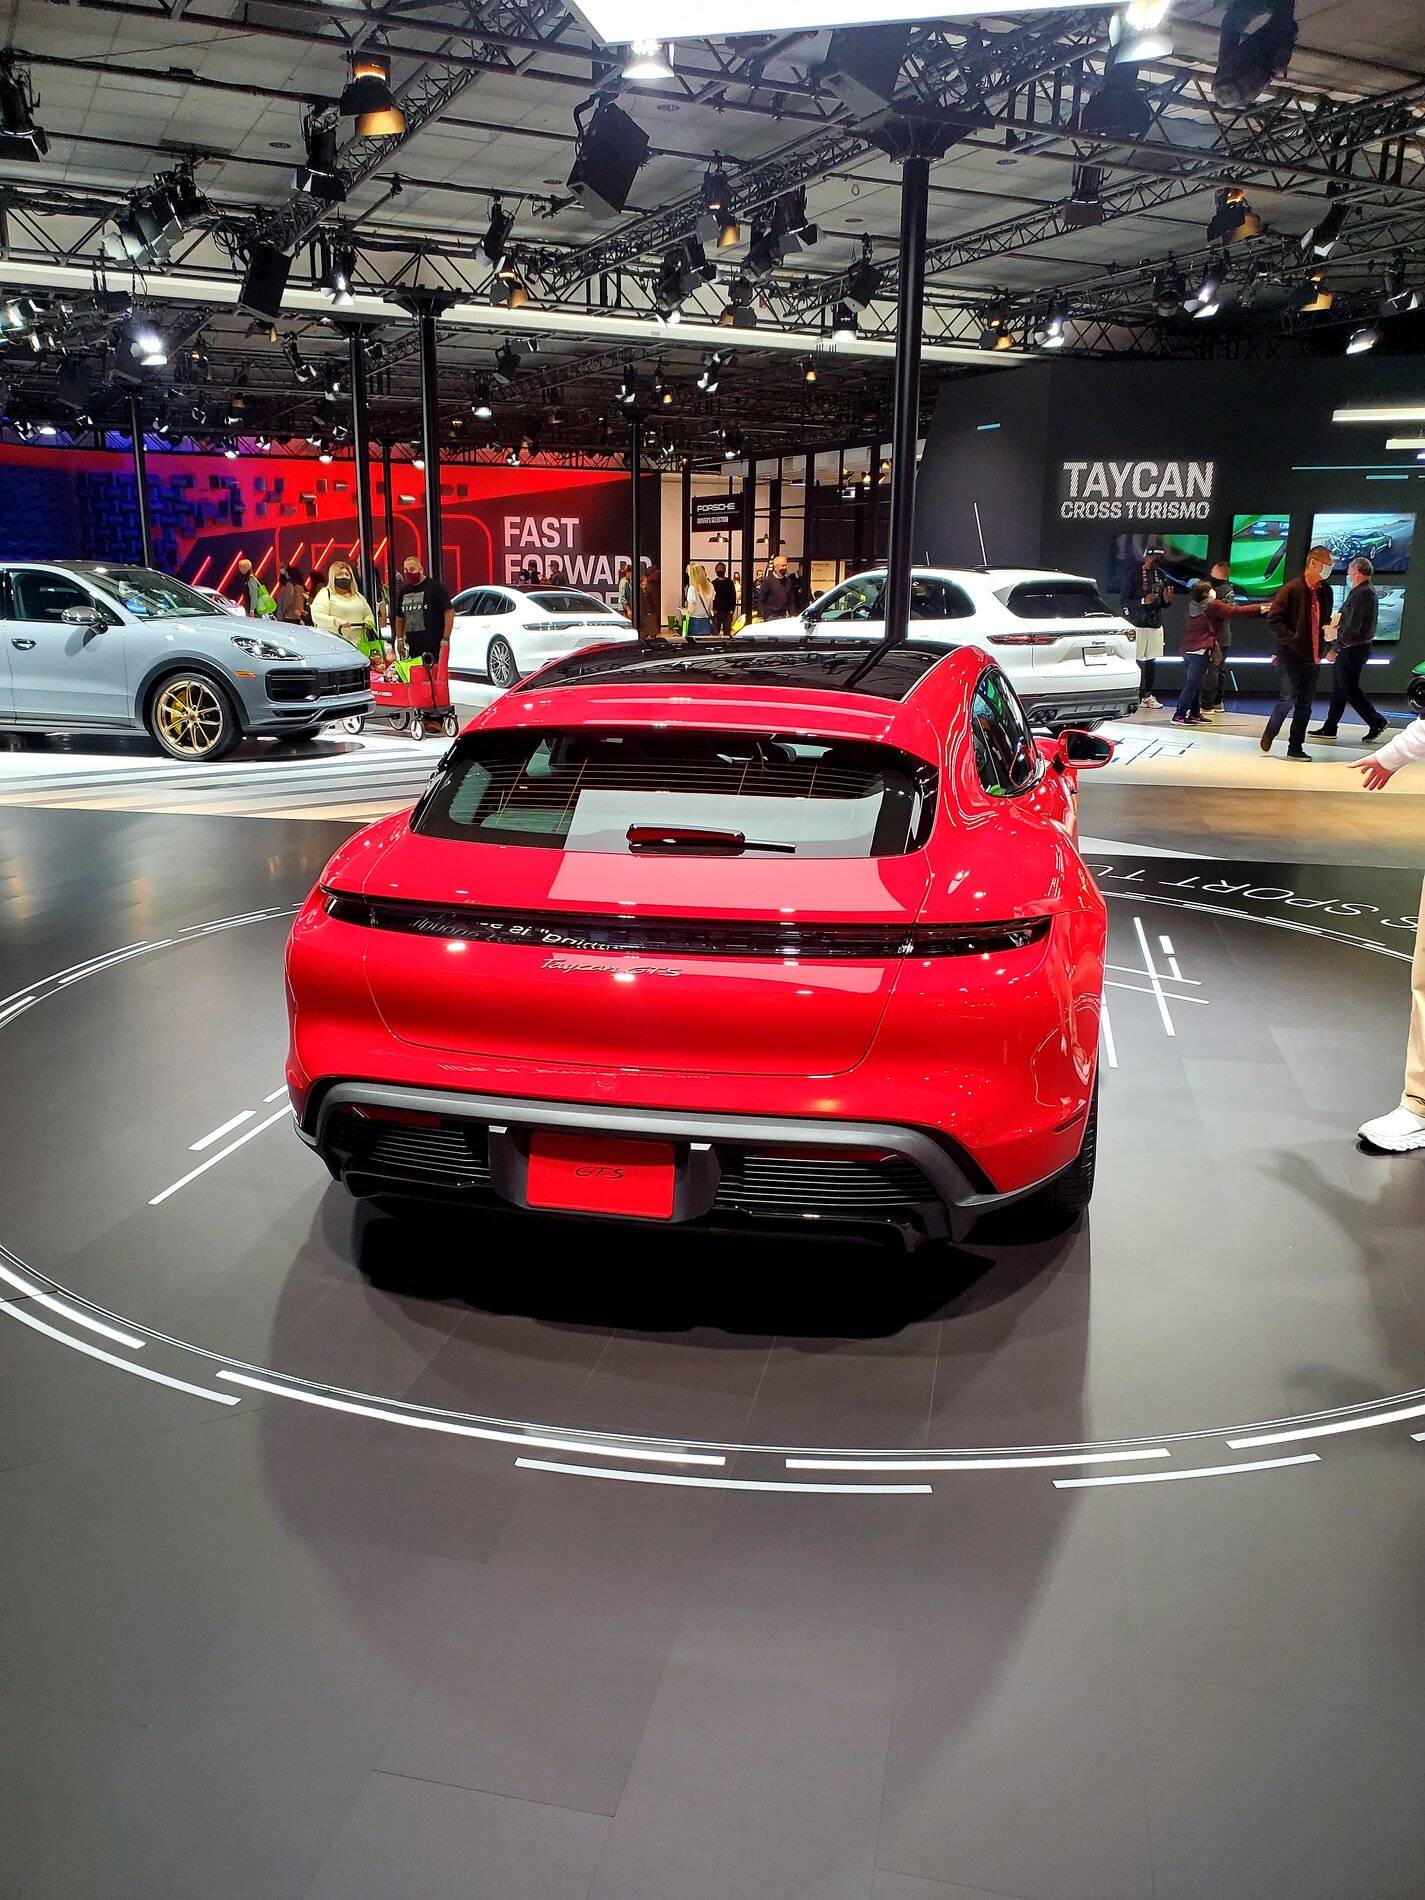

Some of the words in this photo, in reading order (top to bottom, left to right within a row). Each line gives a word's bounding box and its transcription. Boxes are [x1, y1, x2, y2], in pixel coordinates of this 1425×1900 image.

[1063, 462, 1214, 498] TAYCAN
[697, 502, 736, 512] PORSCHE
[1061, 501, 1123, 519] CROSS
[1125, 501, 1210, 519] TURISMO
[504, 516, 580, 548] FAST
[1159, 876, 1380, 915] SPORT
[541, 958, 619, 973] Taycan
[625, 965, 682, 977] GTS
[575, 1166, 625, 1180] GTS
